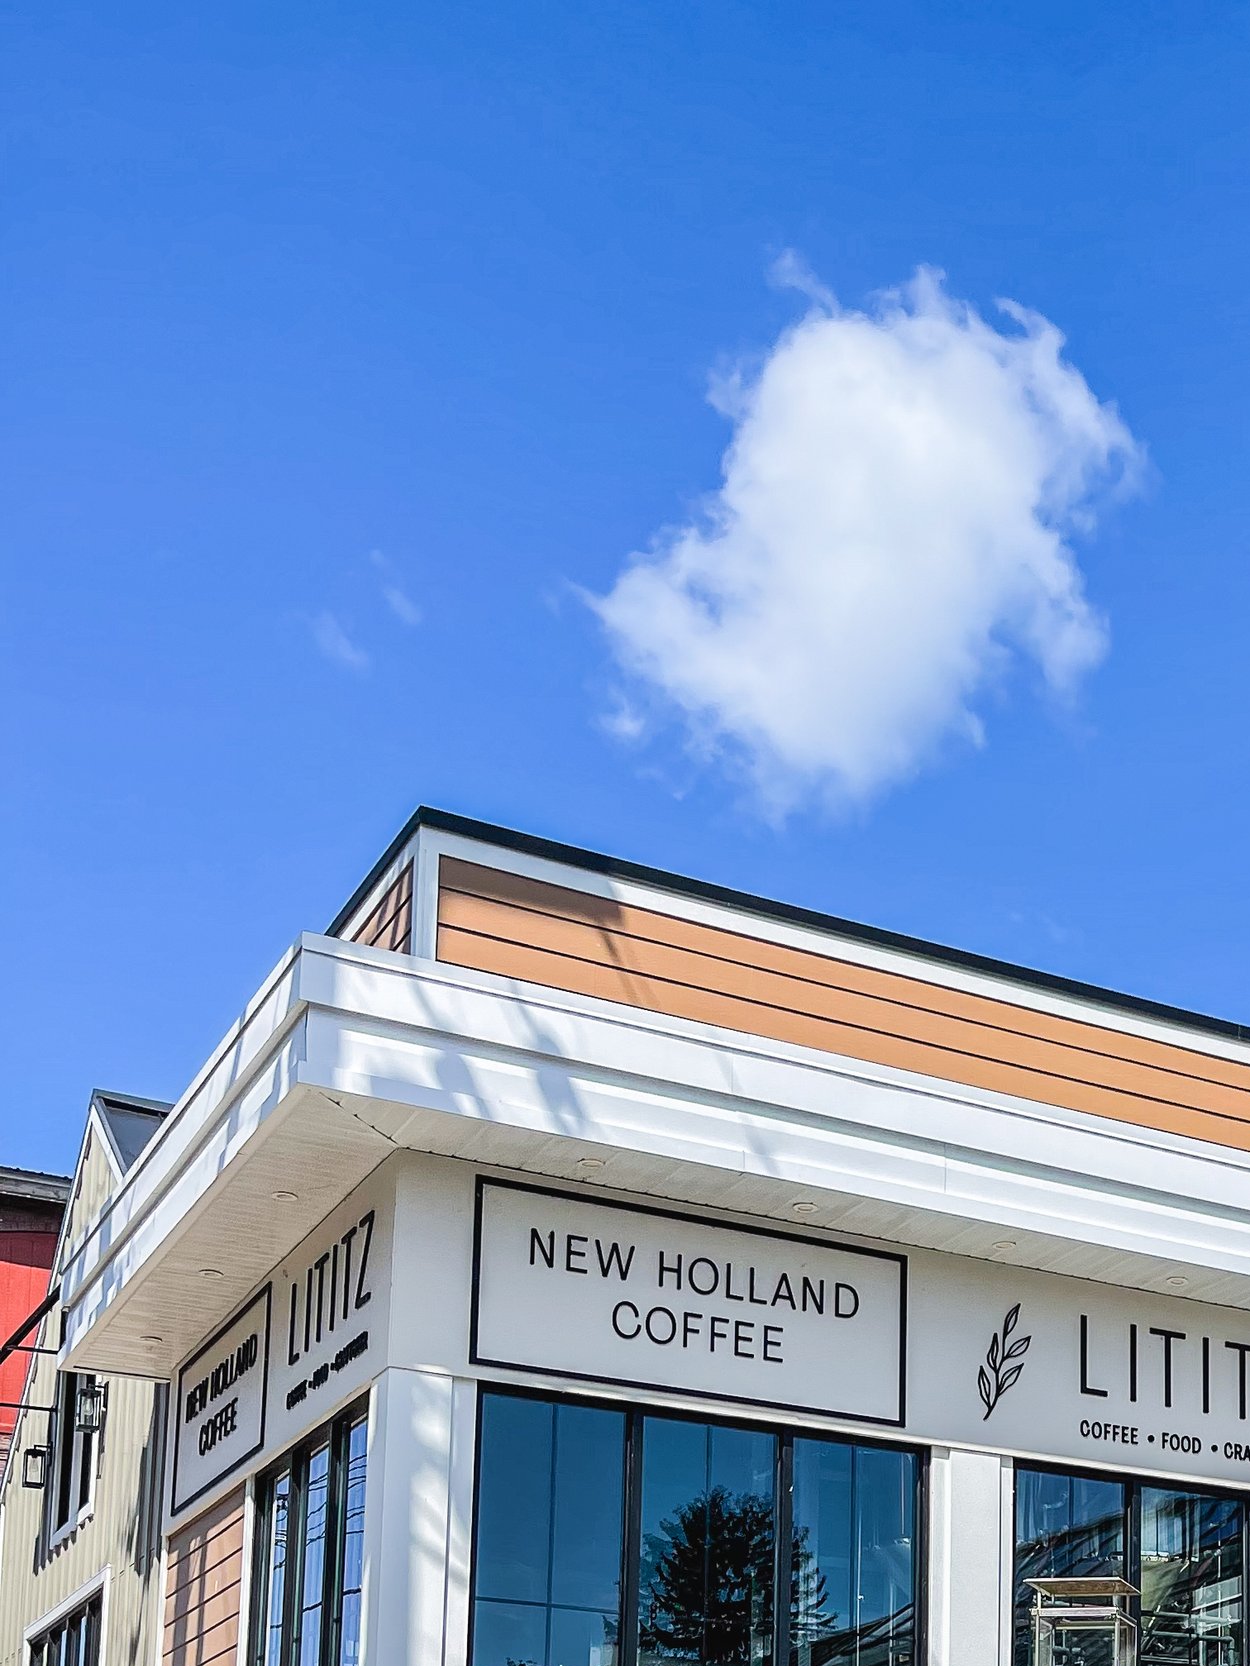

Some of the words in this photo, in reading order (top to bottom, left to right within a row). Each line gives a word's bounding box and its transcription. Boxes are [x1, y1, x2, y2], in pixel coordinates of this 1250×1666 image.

[288, 1209, 375, 1366] LITITZ
[529, 1227, 636, 1281] NEW
[658, 1250, 860, 1319] HOLLAND
[612, 1300, 784, 1364] COFFEE
[210, 1333, 257, 1402] HOLLAND
[198, 1397, 239, 1456] COFFEE
[1079, 1419, 1139, 1445] COFFEE
[1161, 1431, 1202, 1455] FOOD
